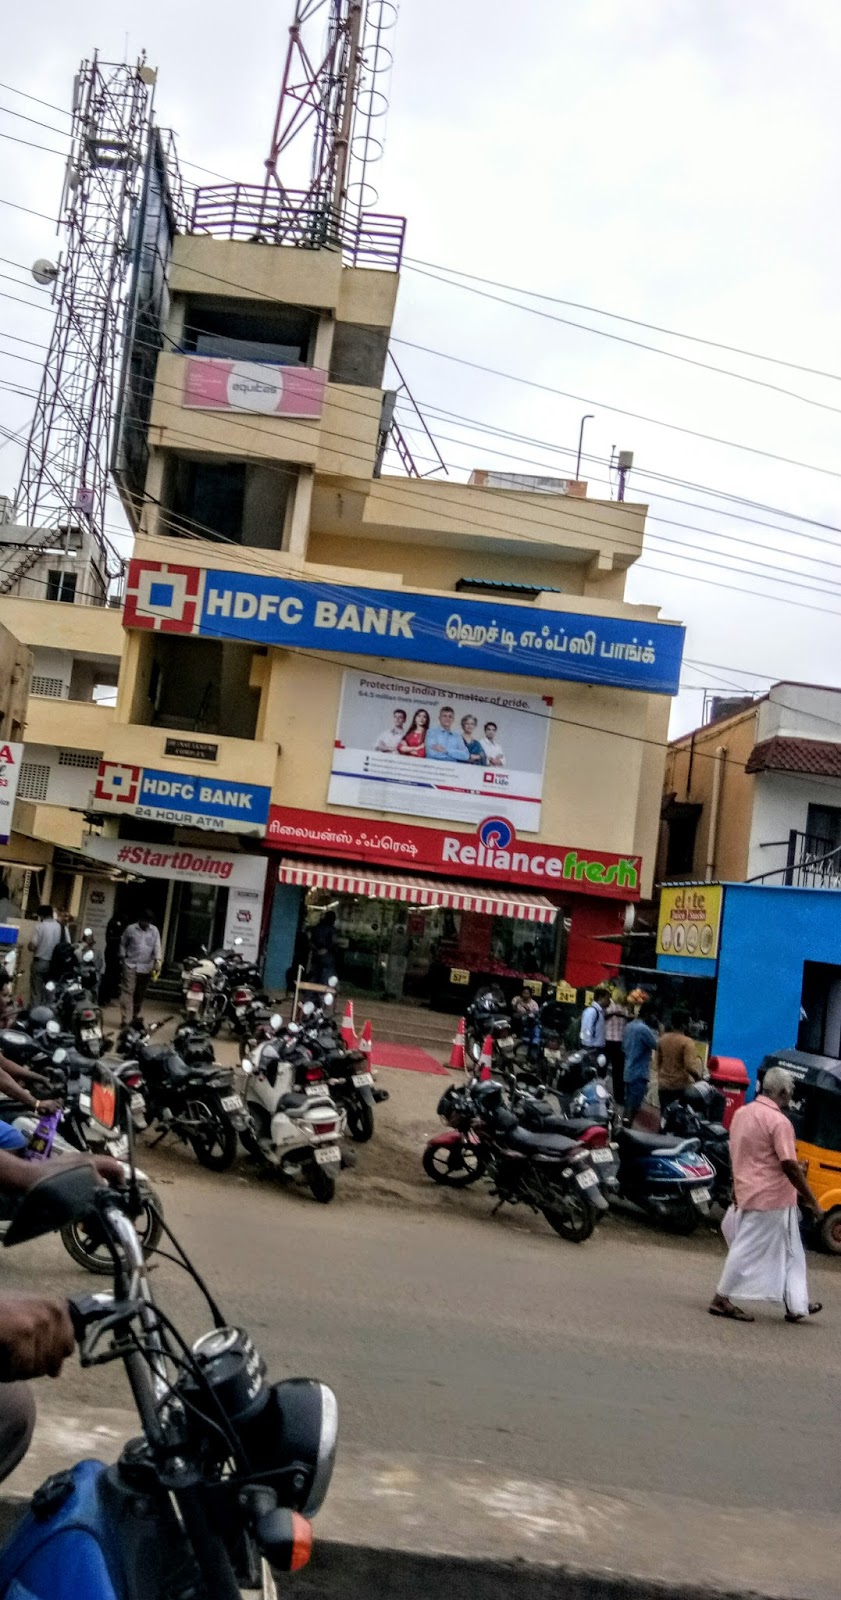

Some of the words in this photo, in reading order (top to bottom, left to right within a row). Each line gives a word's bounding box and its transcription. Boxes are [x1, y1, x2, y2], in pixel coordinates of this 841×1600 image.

[232, 382, 277, 395] equitas
[206, 588, 304, 625] HDFC
[313, 600, 416, 639] BANK
[360, 679, 411, 694] Protecting
[412, 685, 436, 697] India
[438, 688, 446, 698] is
[455, 692, 489, 702] matter
[491, 696, 501, 705] of
[502, 697, 531, 709] pride.
[142, 778, 194, 800] HDFC
[199, 786, 253, 810] BANK
[134, 806, 152, 818] 24
[155, 809, 193, 823] HOUR
[195, 816, 225, 829] ATM
[117, 845, 234, 879] #StartDoing
